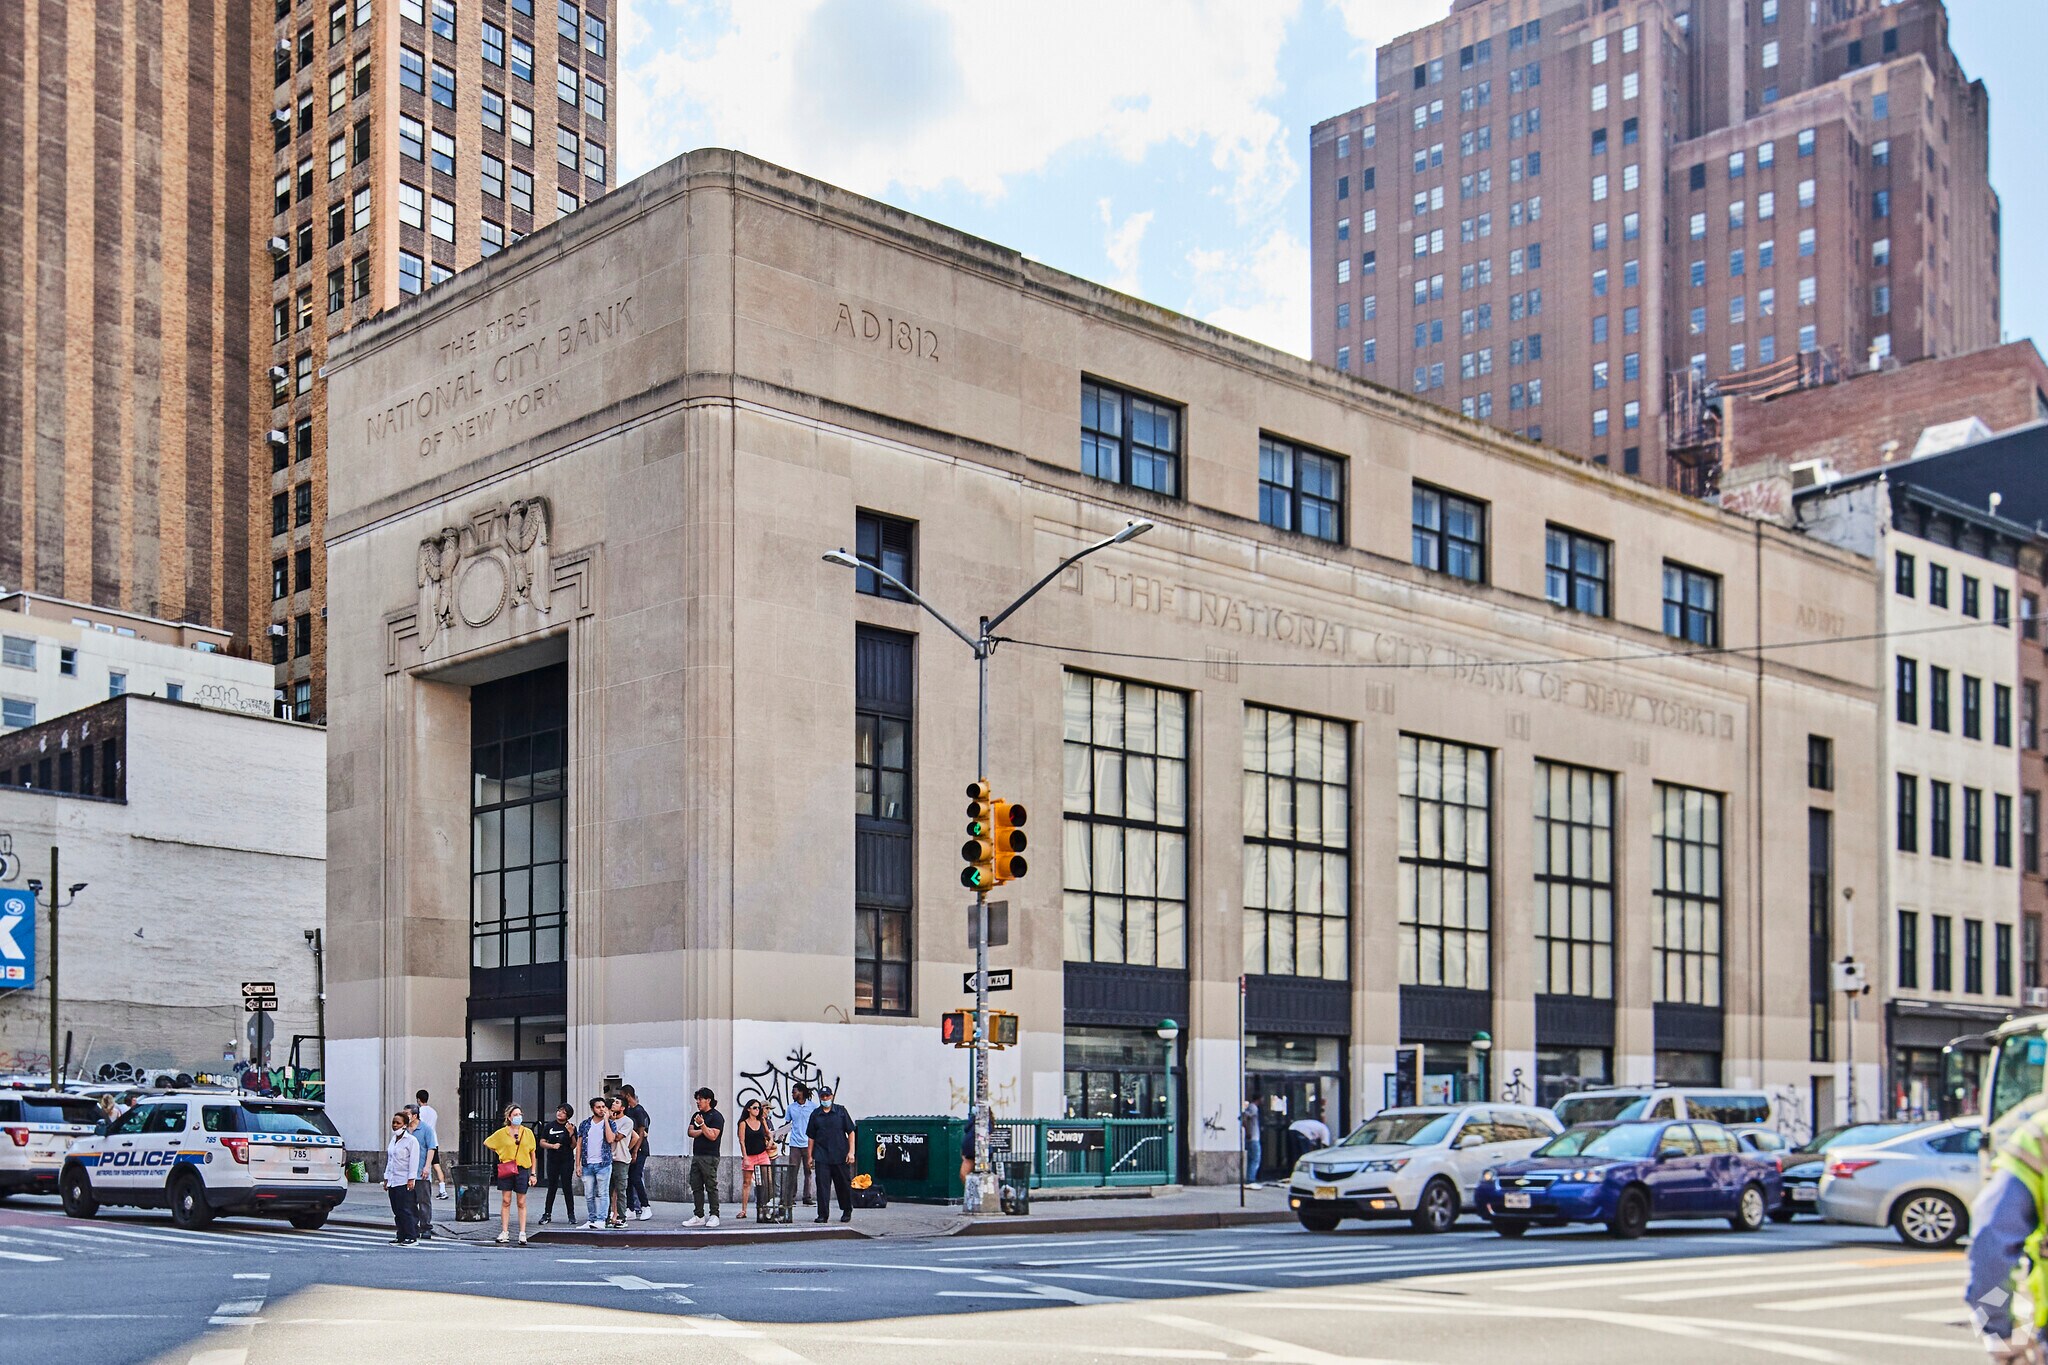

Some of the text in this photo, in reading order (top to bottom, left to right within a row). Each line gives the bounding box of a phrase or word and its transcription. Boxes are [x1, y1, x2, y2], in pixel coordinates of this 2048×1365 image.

[440, 299, 542, 365] THE FIRST
[366, 296, 634, 445] NATIONAL CITY BANK
[419, 379, 562, 458] OF NEW YORK
[1106, 572, 1176, 614] THE
[1200, 589, 1351, 659] NATIONAL
[1375, 632, 1433, 674] CITY
[1452, 649, 1524, 694] BANK
[1539, 671, 1570, 702] OF
[1584, 683, 1638, 720] NEW
[990, 976, 1006, 985] WAY
[205, 1136, 217, 1144] 785
[252, 1133, 340, 1145] POLICE
[876, 1134, 924, 1144] Canal St Station
[1047, 1130, 1084, 1144] Subway
[98, 1150, 178, 1167] POLICE
[293, 1150, 307, 1159] 785
